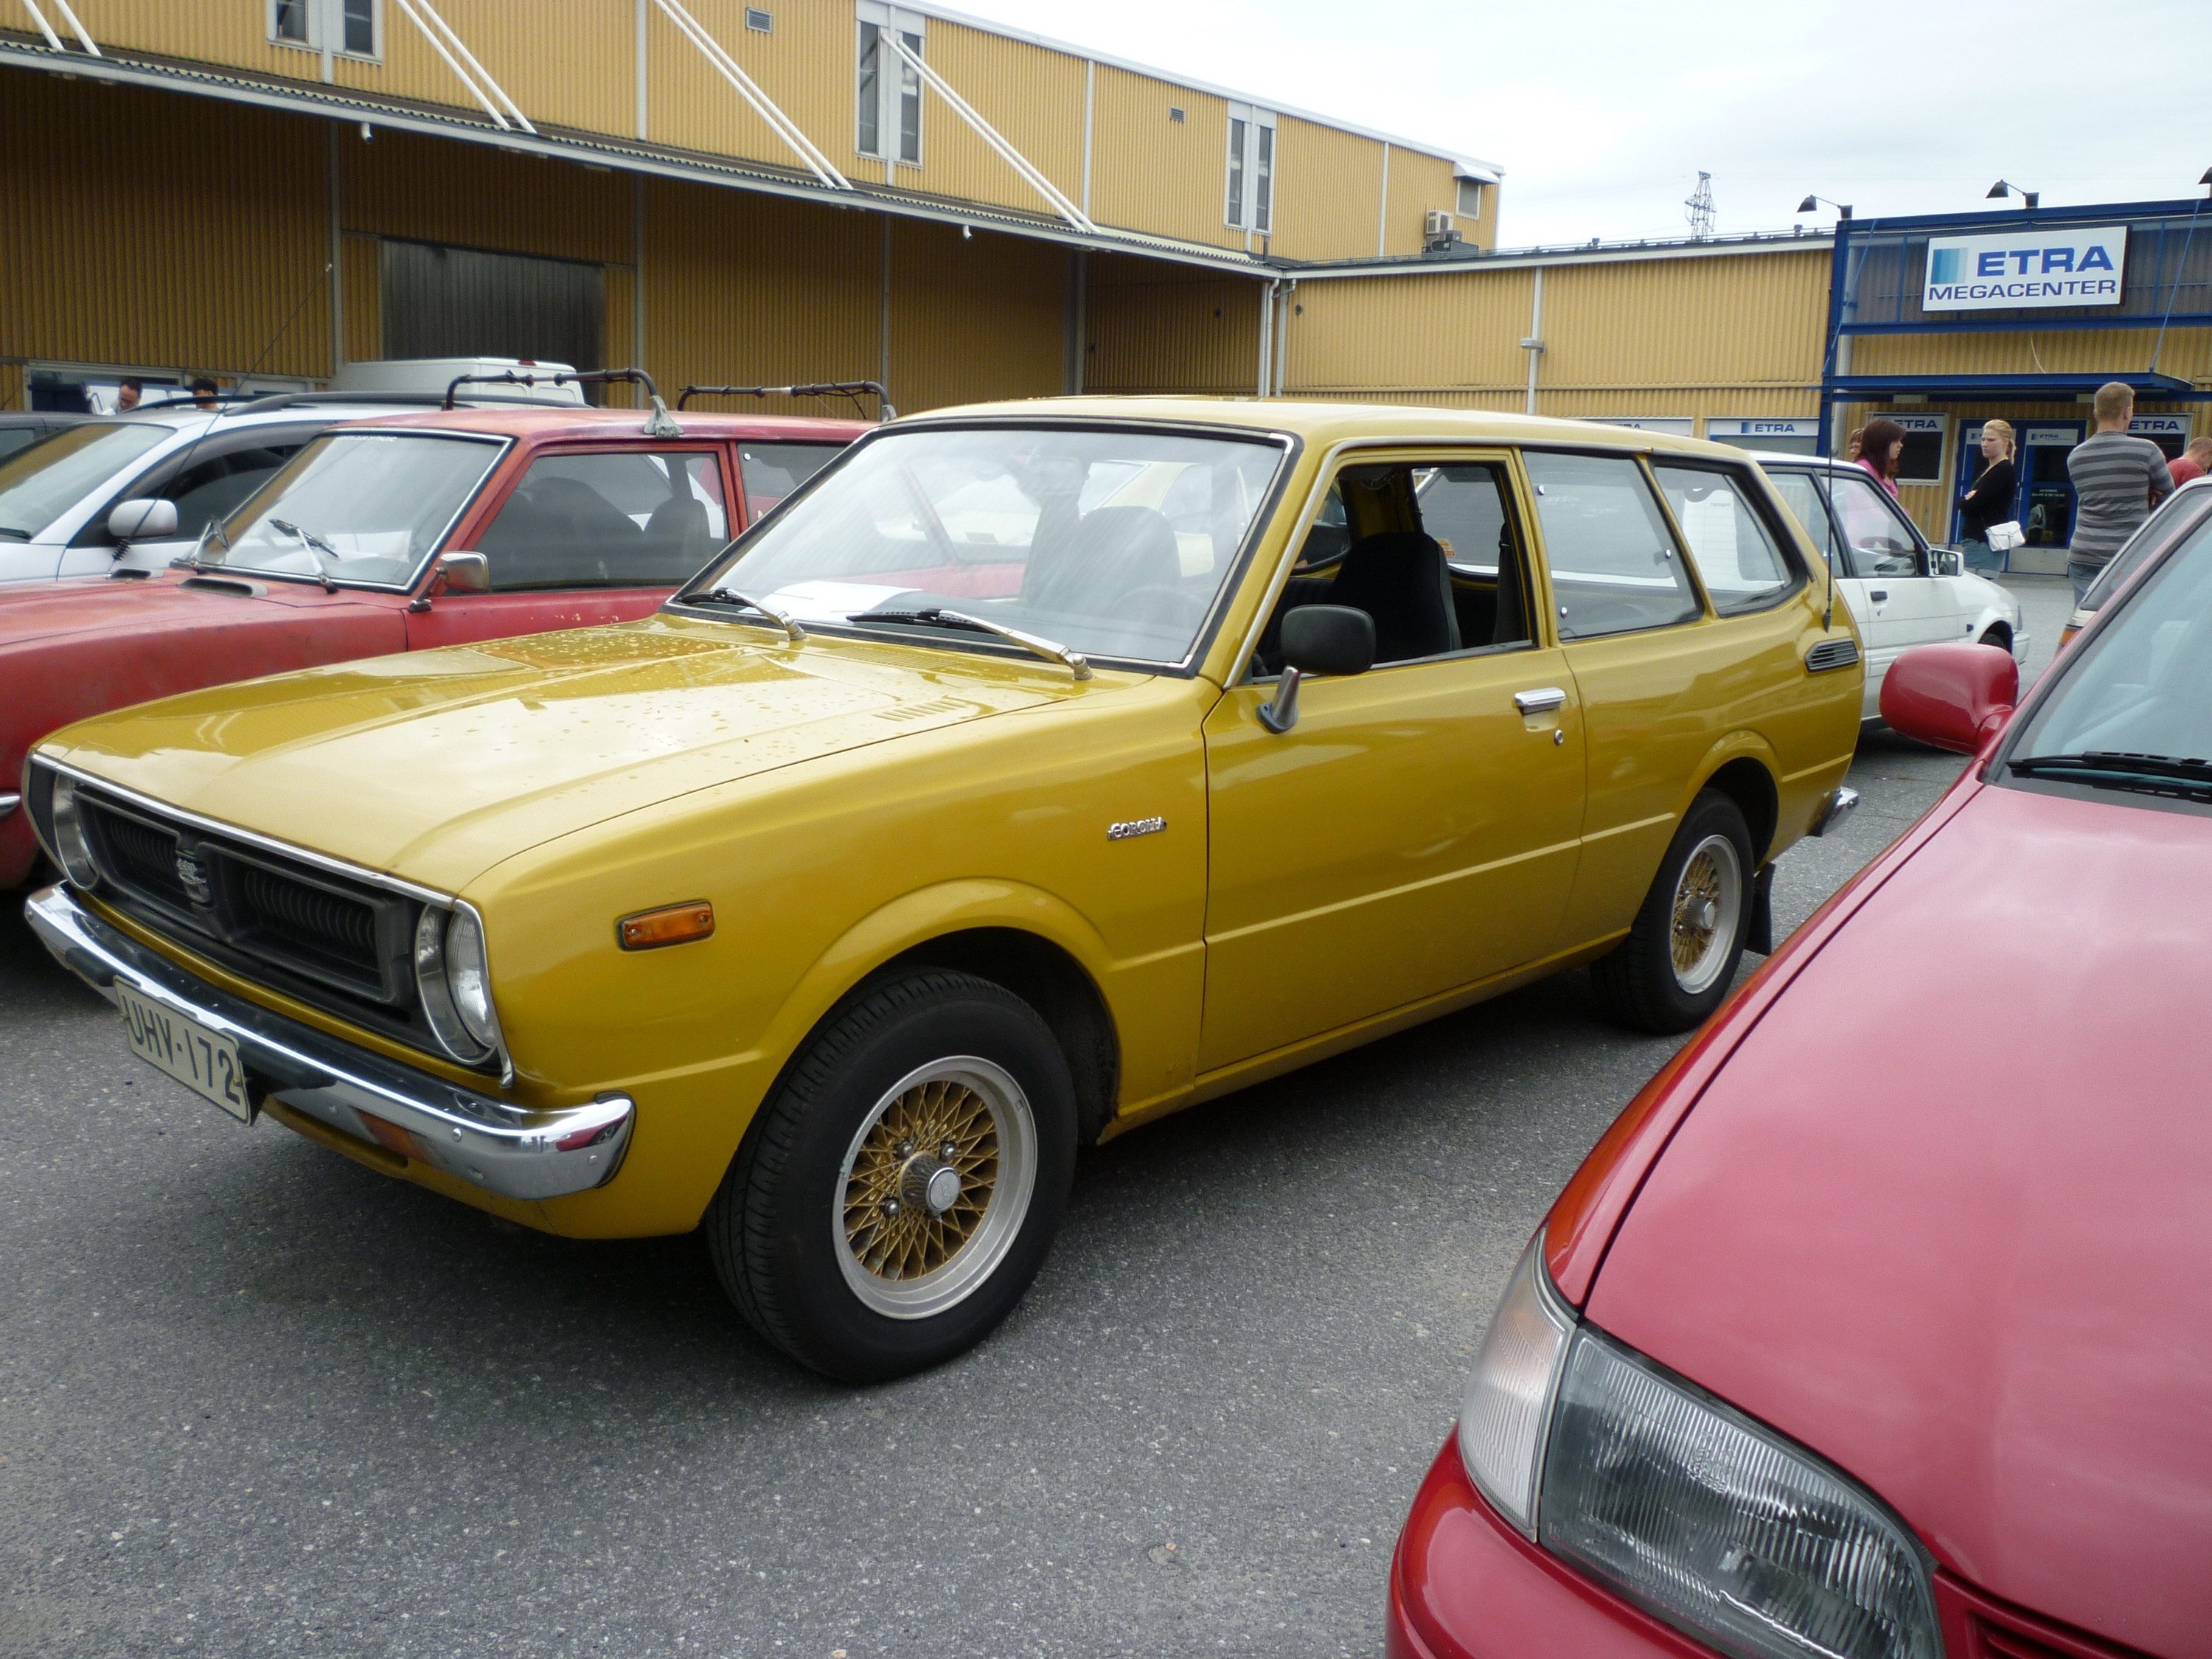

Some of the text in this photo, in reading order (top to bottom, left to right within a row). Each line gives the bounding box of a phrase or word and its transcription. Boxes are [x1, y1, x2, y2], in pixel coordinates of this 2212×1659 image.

[1978, 246, 2114, 277] ETRA
[1928, 279, 2116, 301] MEGACENTER
[1755, 423, 1795, 433] ETRA
[2128, 420, 2180, 430] ETRA
[122, 995, 241, 1105] UHV-172
